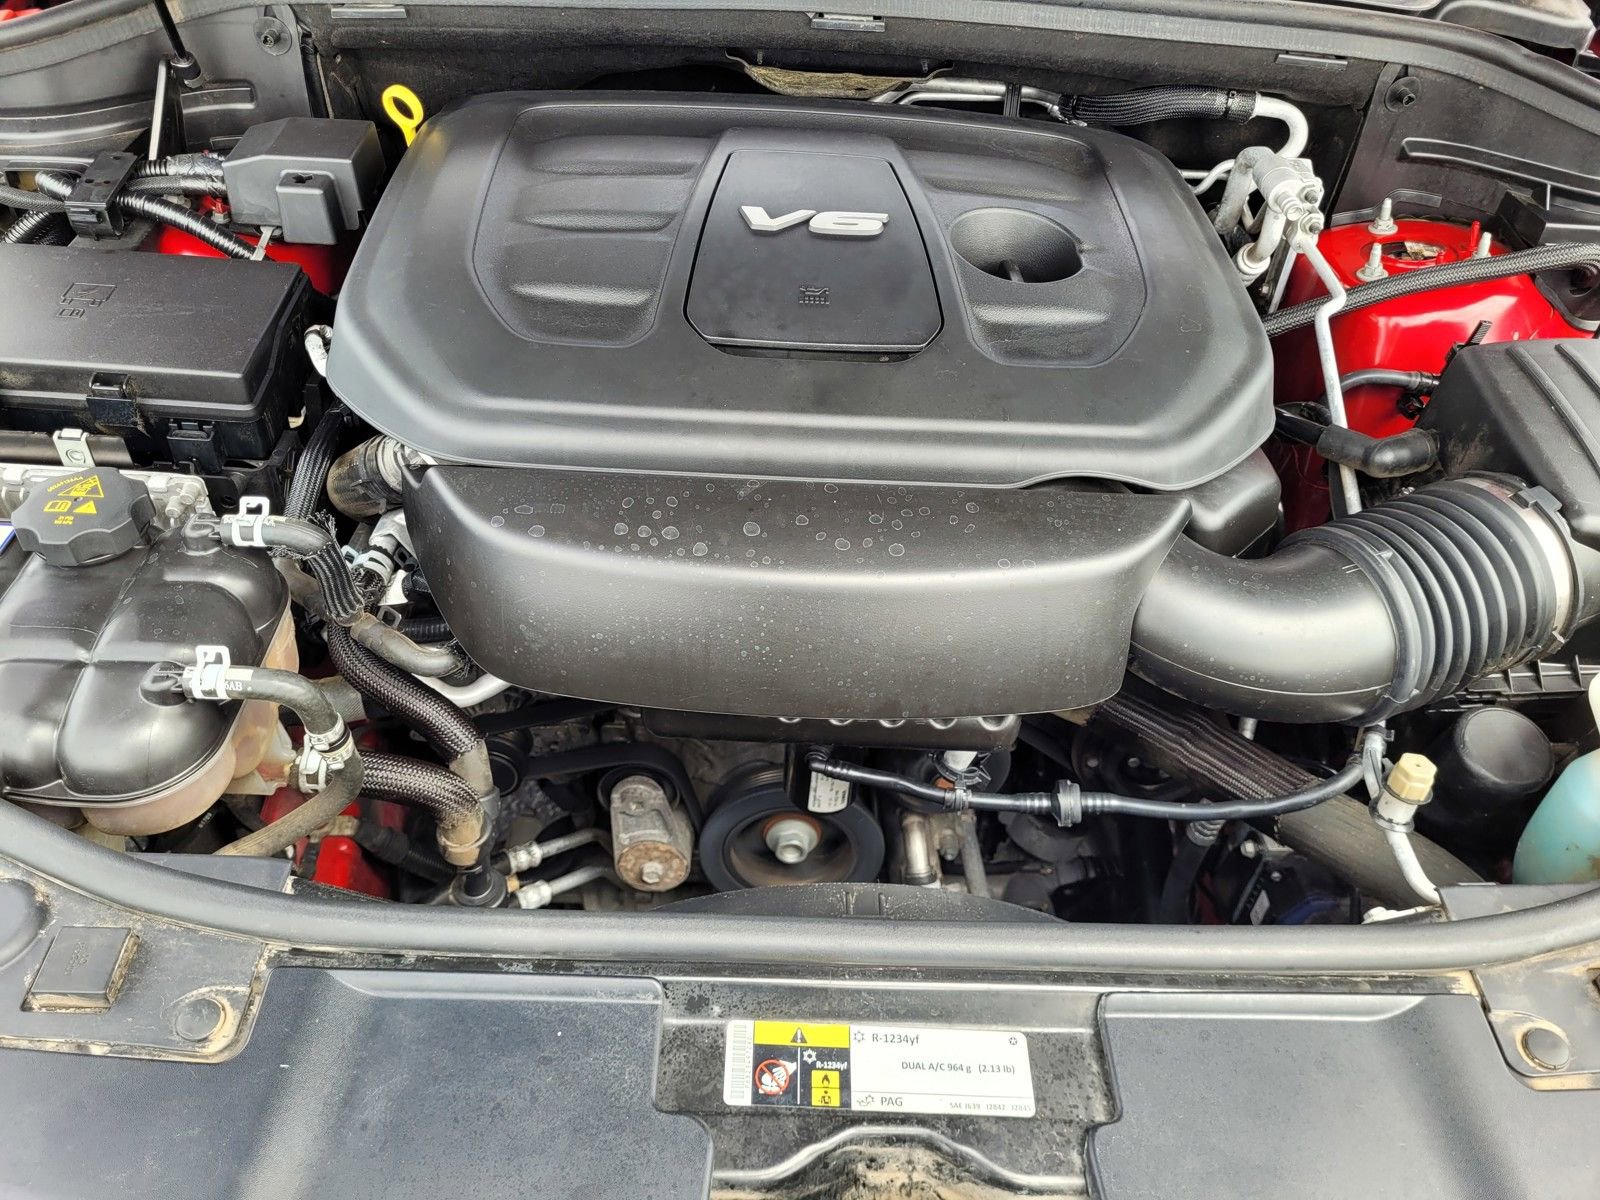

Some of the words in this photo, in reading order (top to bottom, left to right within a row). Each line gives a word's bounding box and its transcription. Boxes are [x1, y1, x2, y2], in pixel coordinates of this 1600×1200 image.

[740, 205, 889, 236] V6
[872, 1033, 920, 1047] R-1234yf
[815, 1060, 848, 1071] R-1234yf
[901, 1061, 926, 1071] DUAL
[928, 1062, 945, 1072] A/C
[947, 1063, 964, 1072] 964
[966, 1065, 972, 1074] g
[978, 1064, 1001, 1074] (2.13
[1003, 1064, 1016, 1075] lb)
[880, 1096, 903, 1107] PAG
